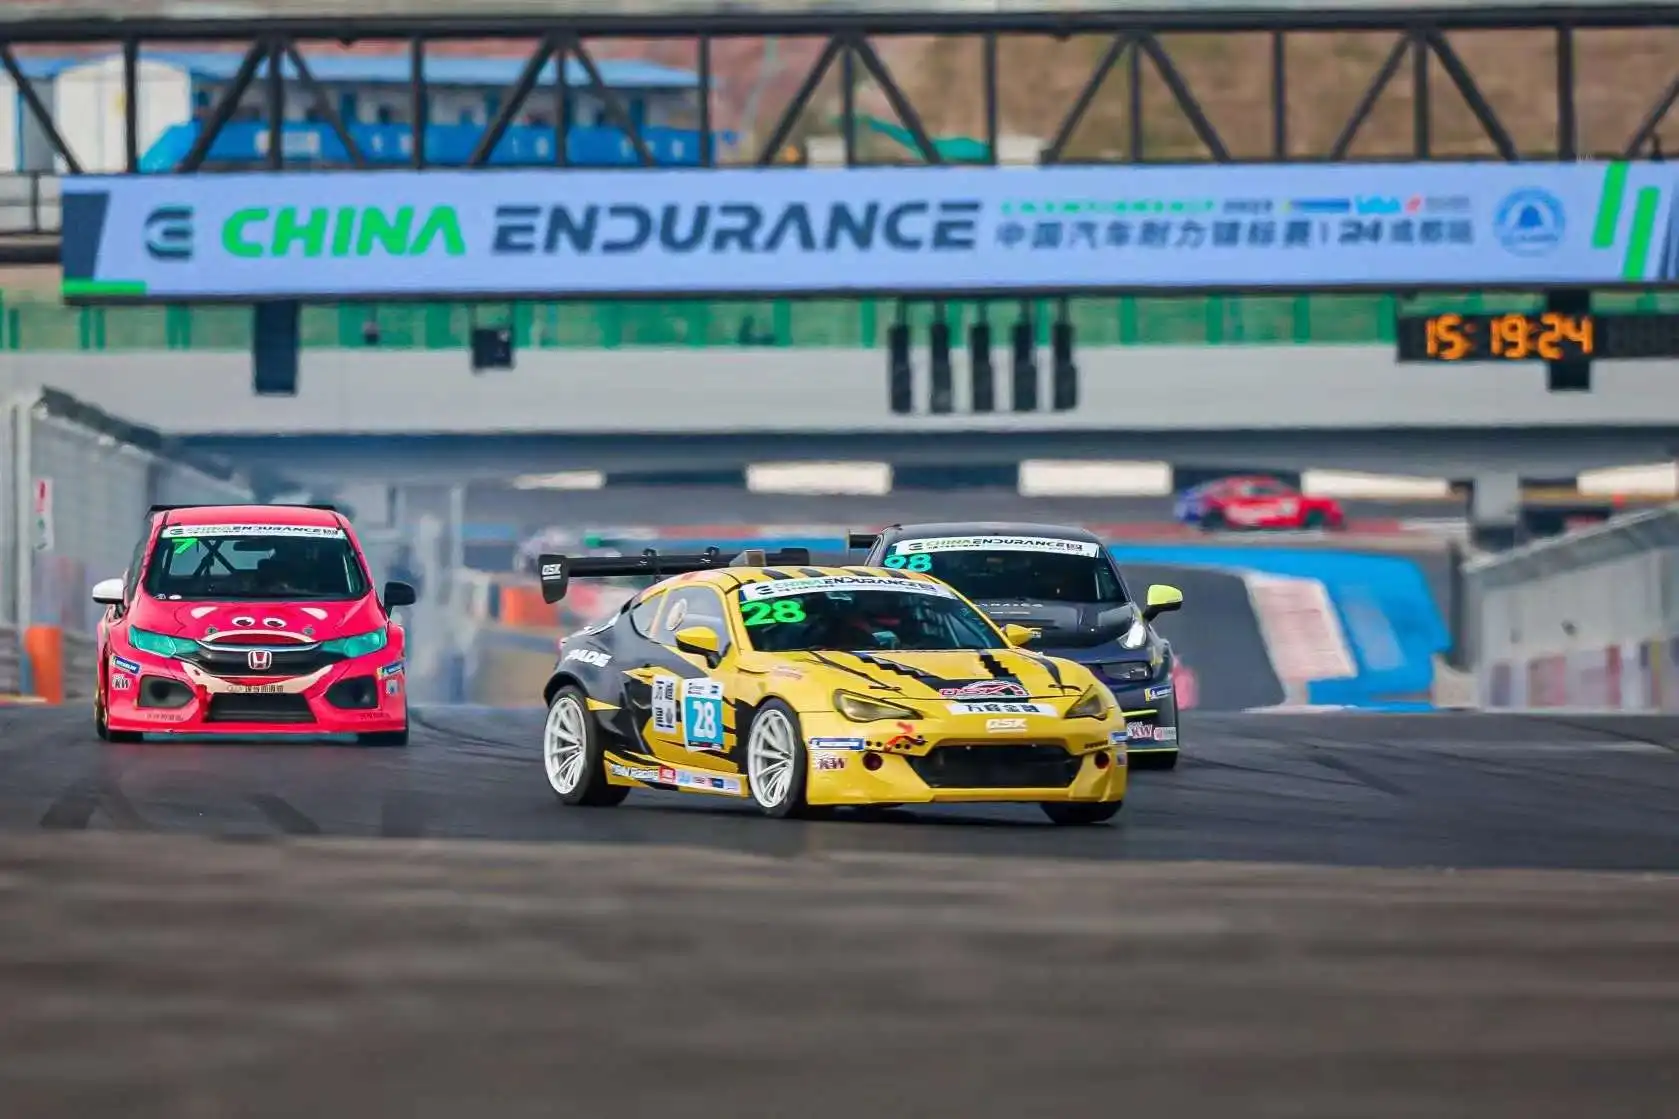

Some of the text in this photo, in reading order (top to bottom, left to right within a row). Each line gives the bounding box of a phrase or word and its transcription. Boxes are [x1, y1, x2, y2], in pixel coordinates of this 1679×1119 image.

[221, 200, 982, 258] CHINA ENDURANCE
[1425, 312, 1593, 360] 15:19:24
[972, 538, 1066, 549] ENDURANCE
[824, 576, 921, 588] ENDURANCE
[741, 600, 806, 626] 28
[693, 701, 717, 739] 28
